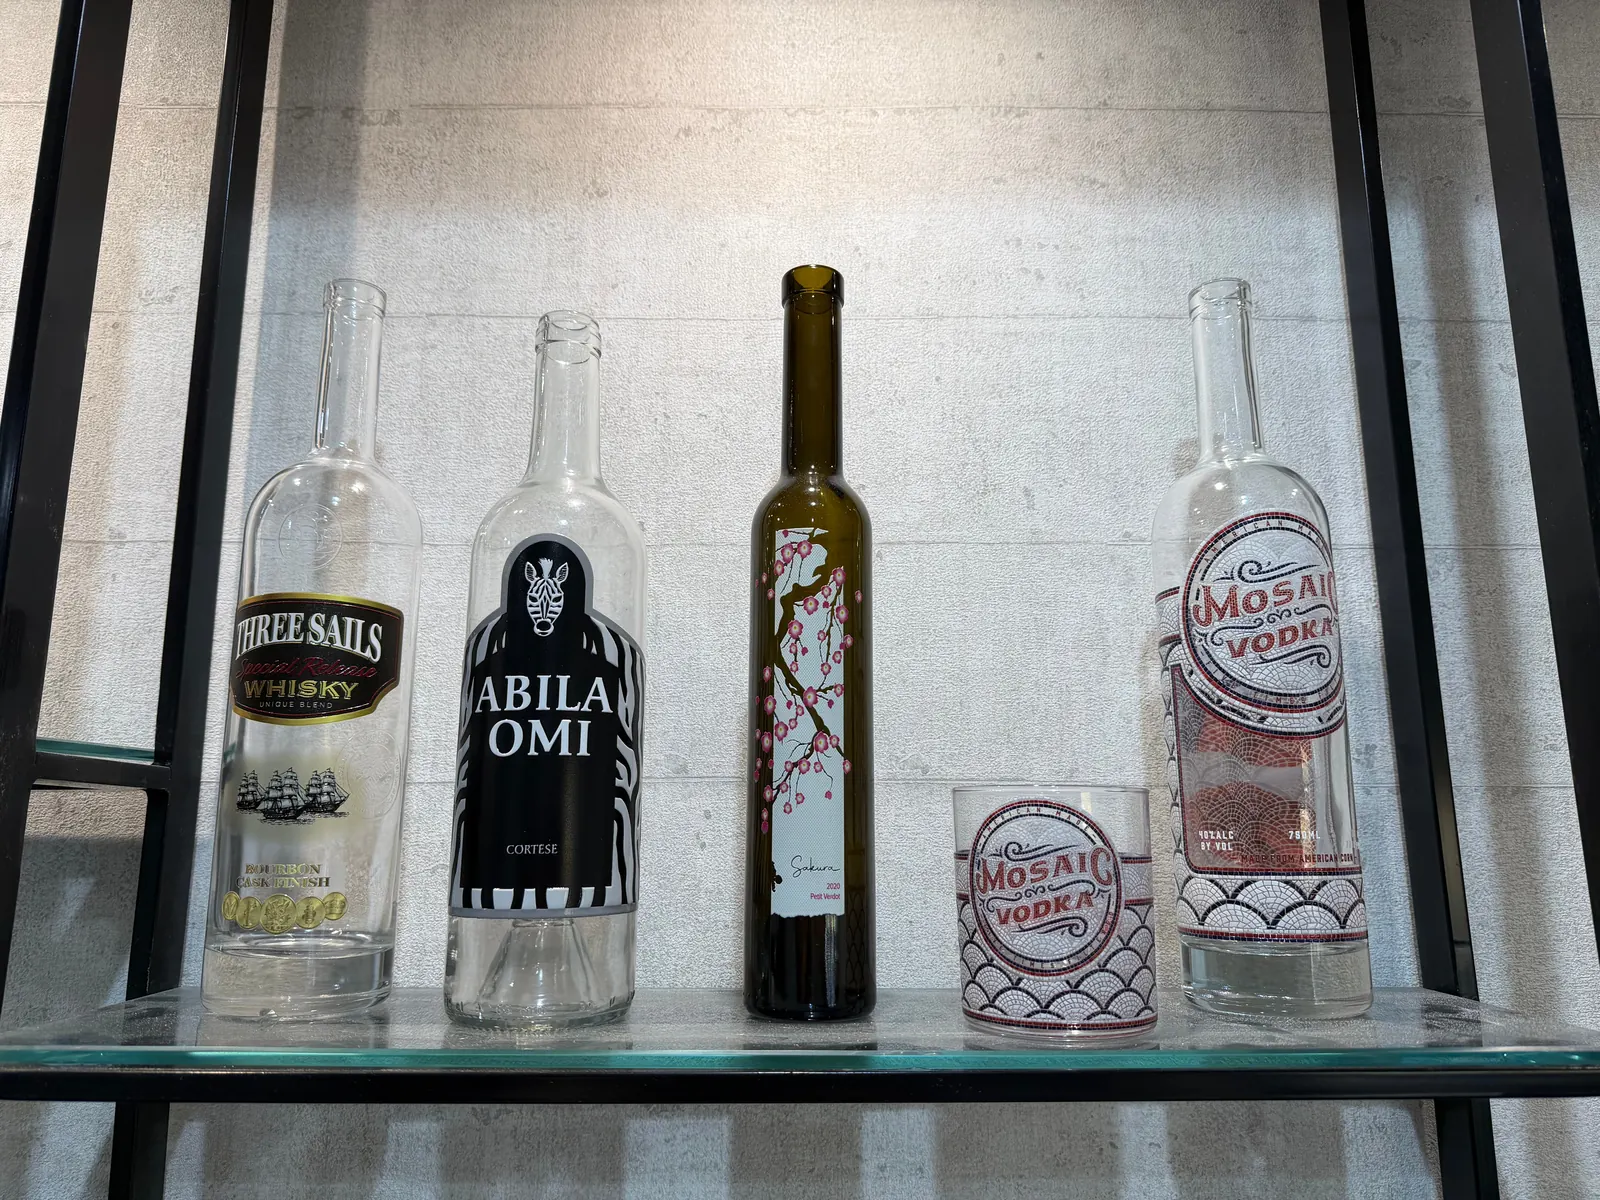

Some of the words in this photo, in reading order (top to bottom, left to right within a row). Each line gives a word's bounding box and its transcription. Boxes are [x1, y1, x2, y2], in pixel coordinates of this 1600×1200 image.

[1204, 520, 1283, 562] AMERICAN
[235, 612, 304, 660] THREE
[306, 612, 383, 664] SAILS
[1227, 616, 1334, 659] VODKA
[236, 657, 297, 679] Special
[299, 657, 378, 678] Release
[244, 679, 359, 700] WHISKY
[475, 674, 614, 714] ABILA
[259, 701, 295, 709] UNIQUE
[300, 701, 333, 709] BLEND
[488, 718, 592, 757] OMI
[982, 807, 1041, 840] AMERICAN
[1055, 811, 1090, 831] MADE
[506, 842, 558, 856] CORTESE
[1200, 841, 1211, 851] BY
[1215, 841, 1233, 851] VOL
[790, 854, 841, 878] Sakura
[1241, 853, 1266, 863] MADE
[1270, 853, 1295, 863] FROM
[1299, 853, 1338, 863] AMERICAN
[245, 863, 323, 875] BOURBON
[975, 847, 1113, 894] MOSAIC
[236, 876, 271, 888] CASK
[273, 876, 331, 888] FINISH
[826, 882, 841, 890] 2020
[810, 892, 823, 900] Petit
[824, 892, 841, 900] Verdot
[995, 891, 1095, 925] VODKA
[1012, 955, 1055, 969] TIMES
